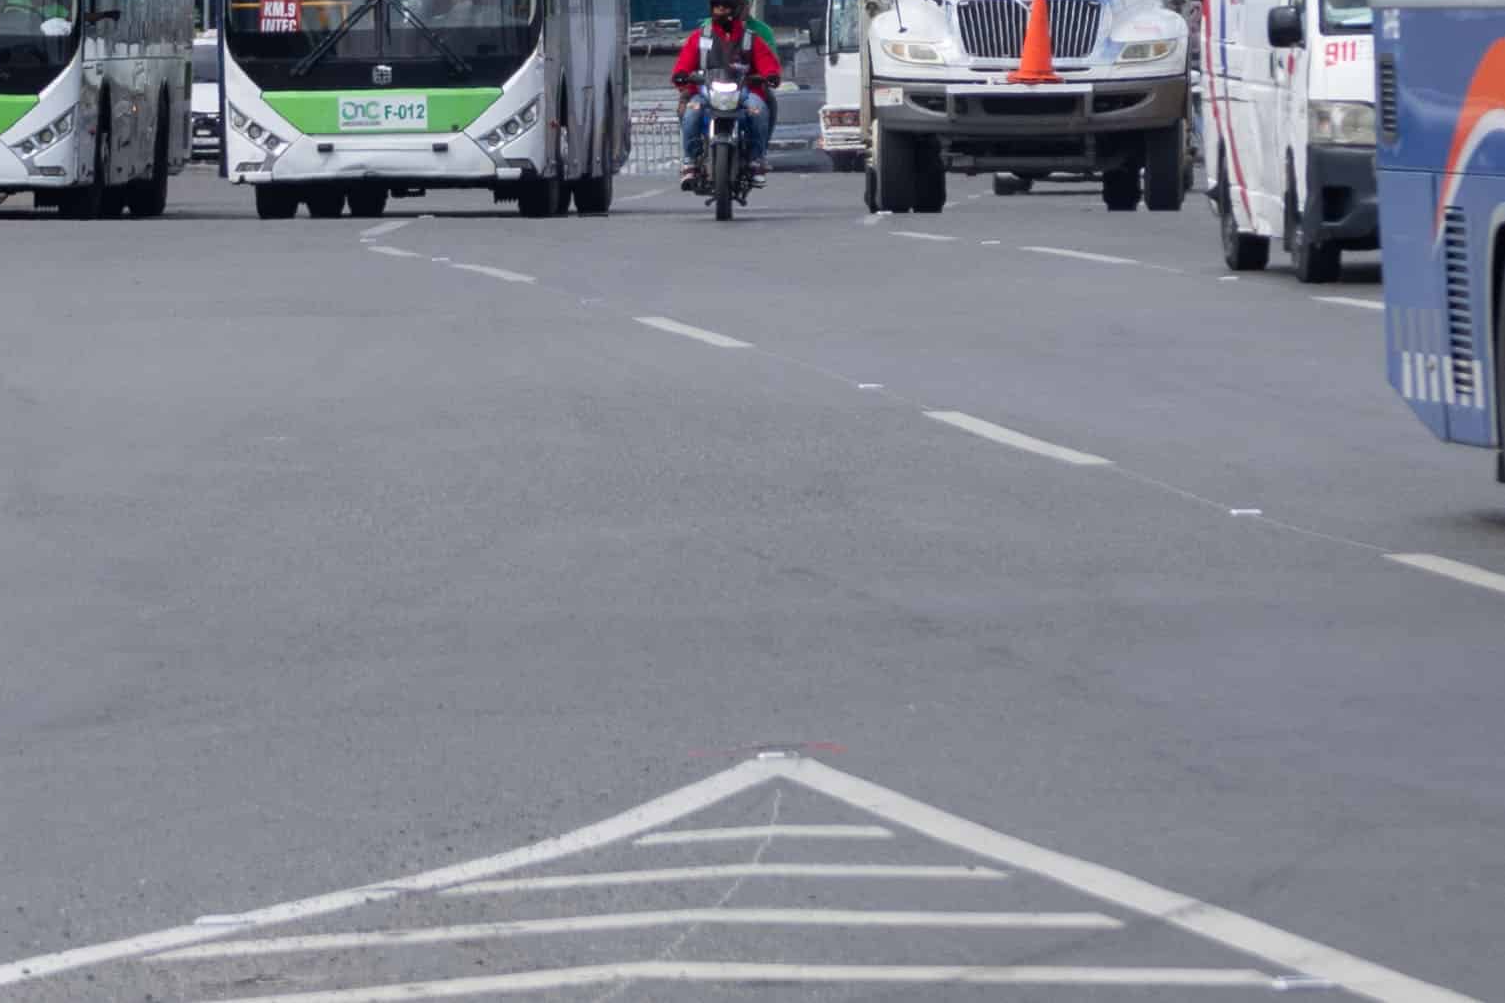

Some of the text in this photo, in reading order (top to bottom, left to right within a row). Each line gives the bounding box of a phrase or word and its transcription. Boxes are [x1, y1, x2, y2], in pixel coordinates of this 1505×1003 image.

[264, 1, 297, 18] KM.9
[1325, 41, 1357, 67] 911
[384, 103, 425, 120] F-012
